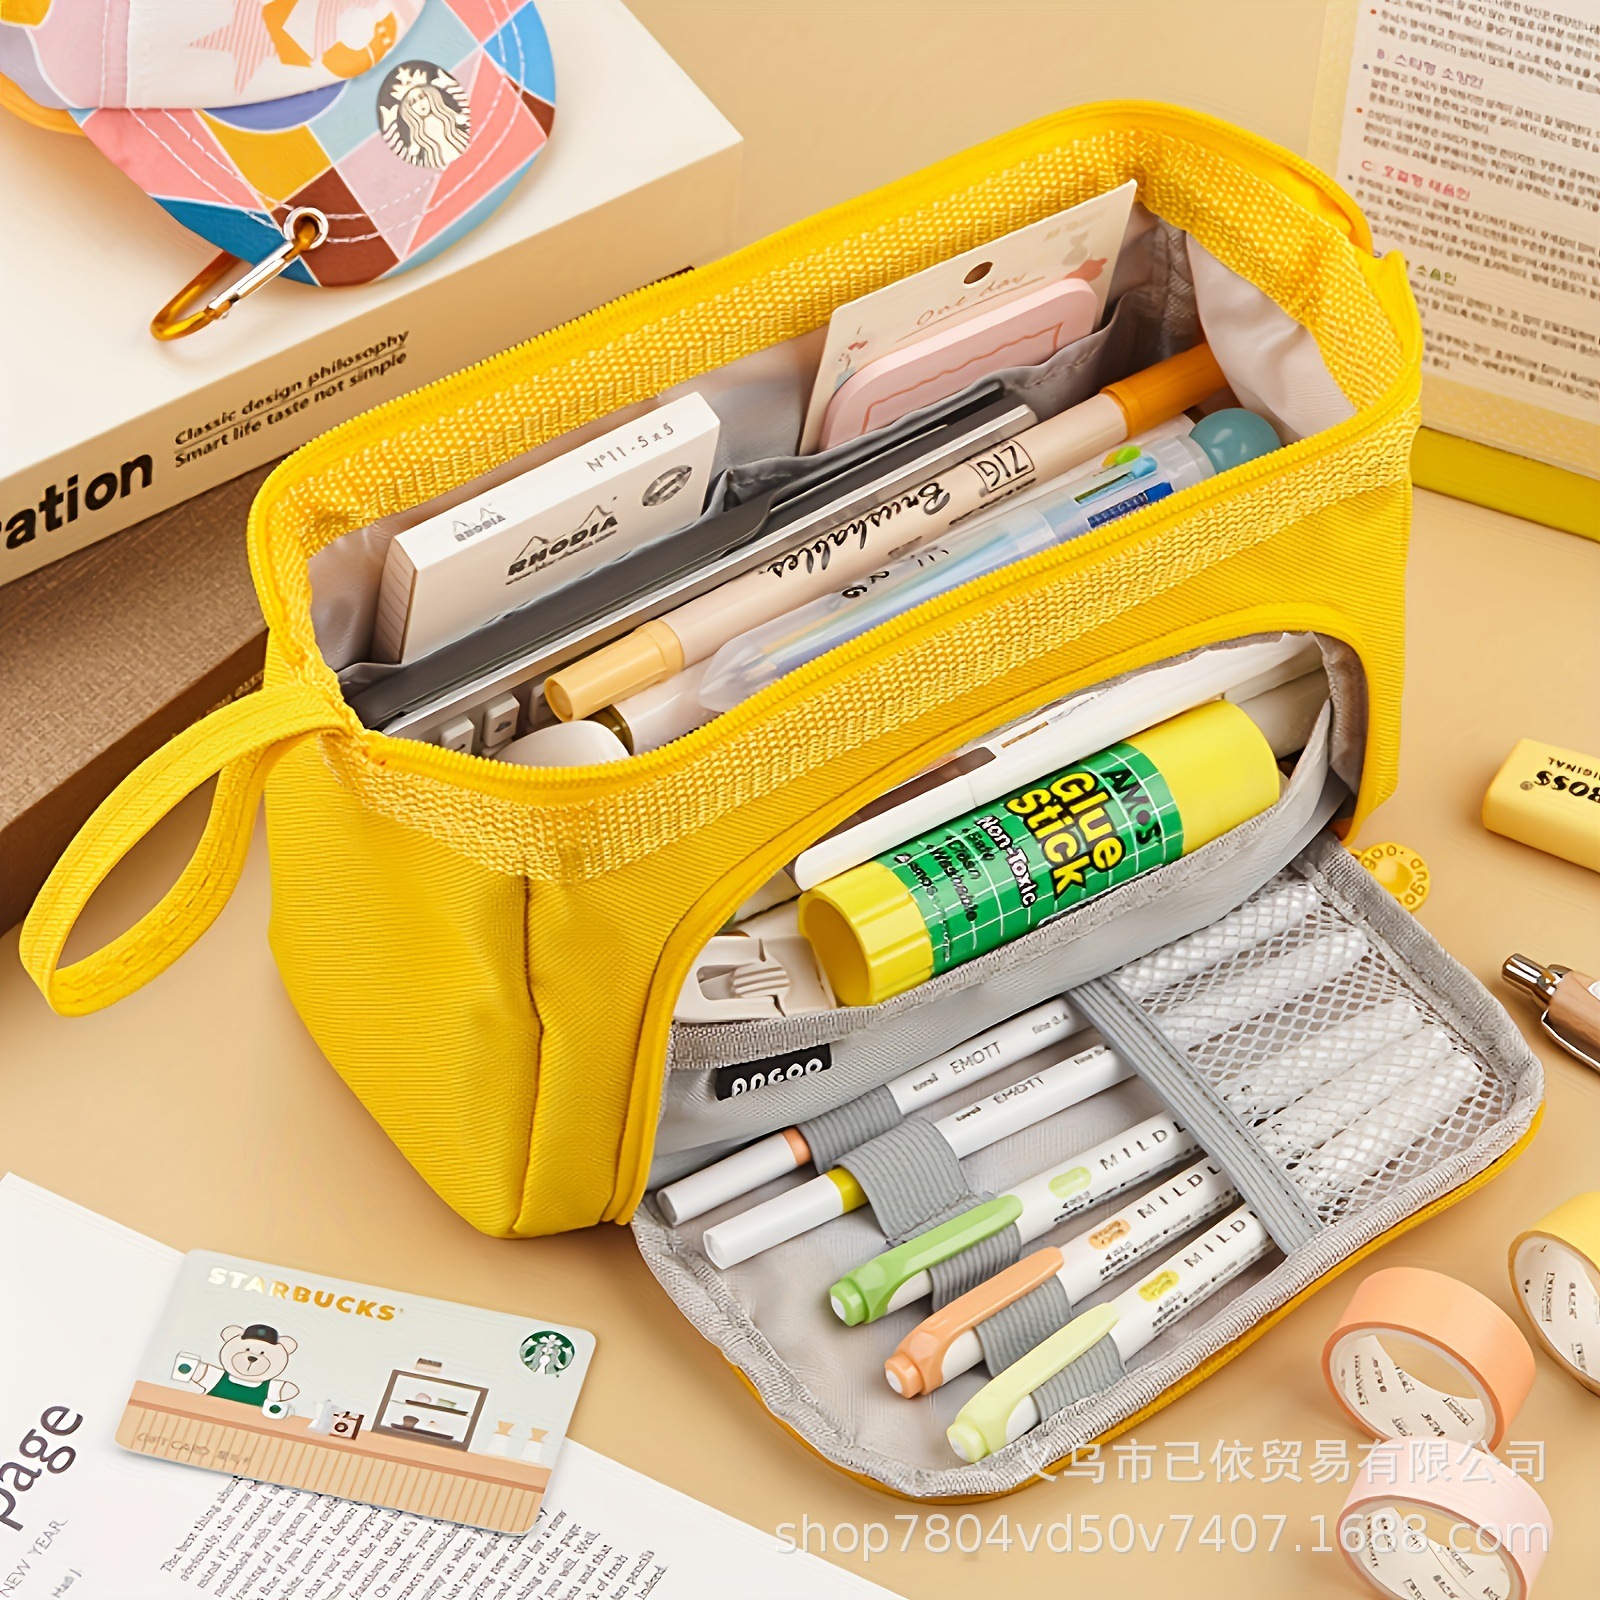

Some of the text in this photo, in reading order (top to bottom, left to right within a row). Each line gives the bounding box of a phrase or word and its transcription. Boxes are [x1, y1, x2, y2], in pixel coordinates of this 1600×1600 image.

[174, 351, 408, 468] Smart life taste not simple
[175, 330, 410, 445] Classic design philosophy
[0, 453, 153, 550] ation
[976, 446, 1030, 488] ZIG
[766, 482, 950, 578] Brushables
[1006, 788, 1091, 895] Stick
[1049, 772, 1124, 870] Glue
[1099, 769, 1162, 845] AMOS
[975, 815, 1037, 907] Non-Toxic
[950, 1041, 1001, 1075] EMOTT
[993, 1074, 1045, 1104] EMOTT
[207, 1266, 397, 1323] STARBUCKS
[0, 1558, 31, 1598] NEW
[26, 1519, 69, 1557] YEAR
